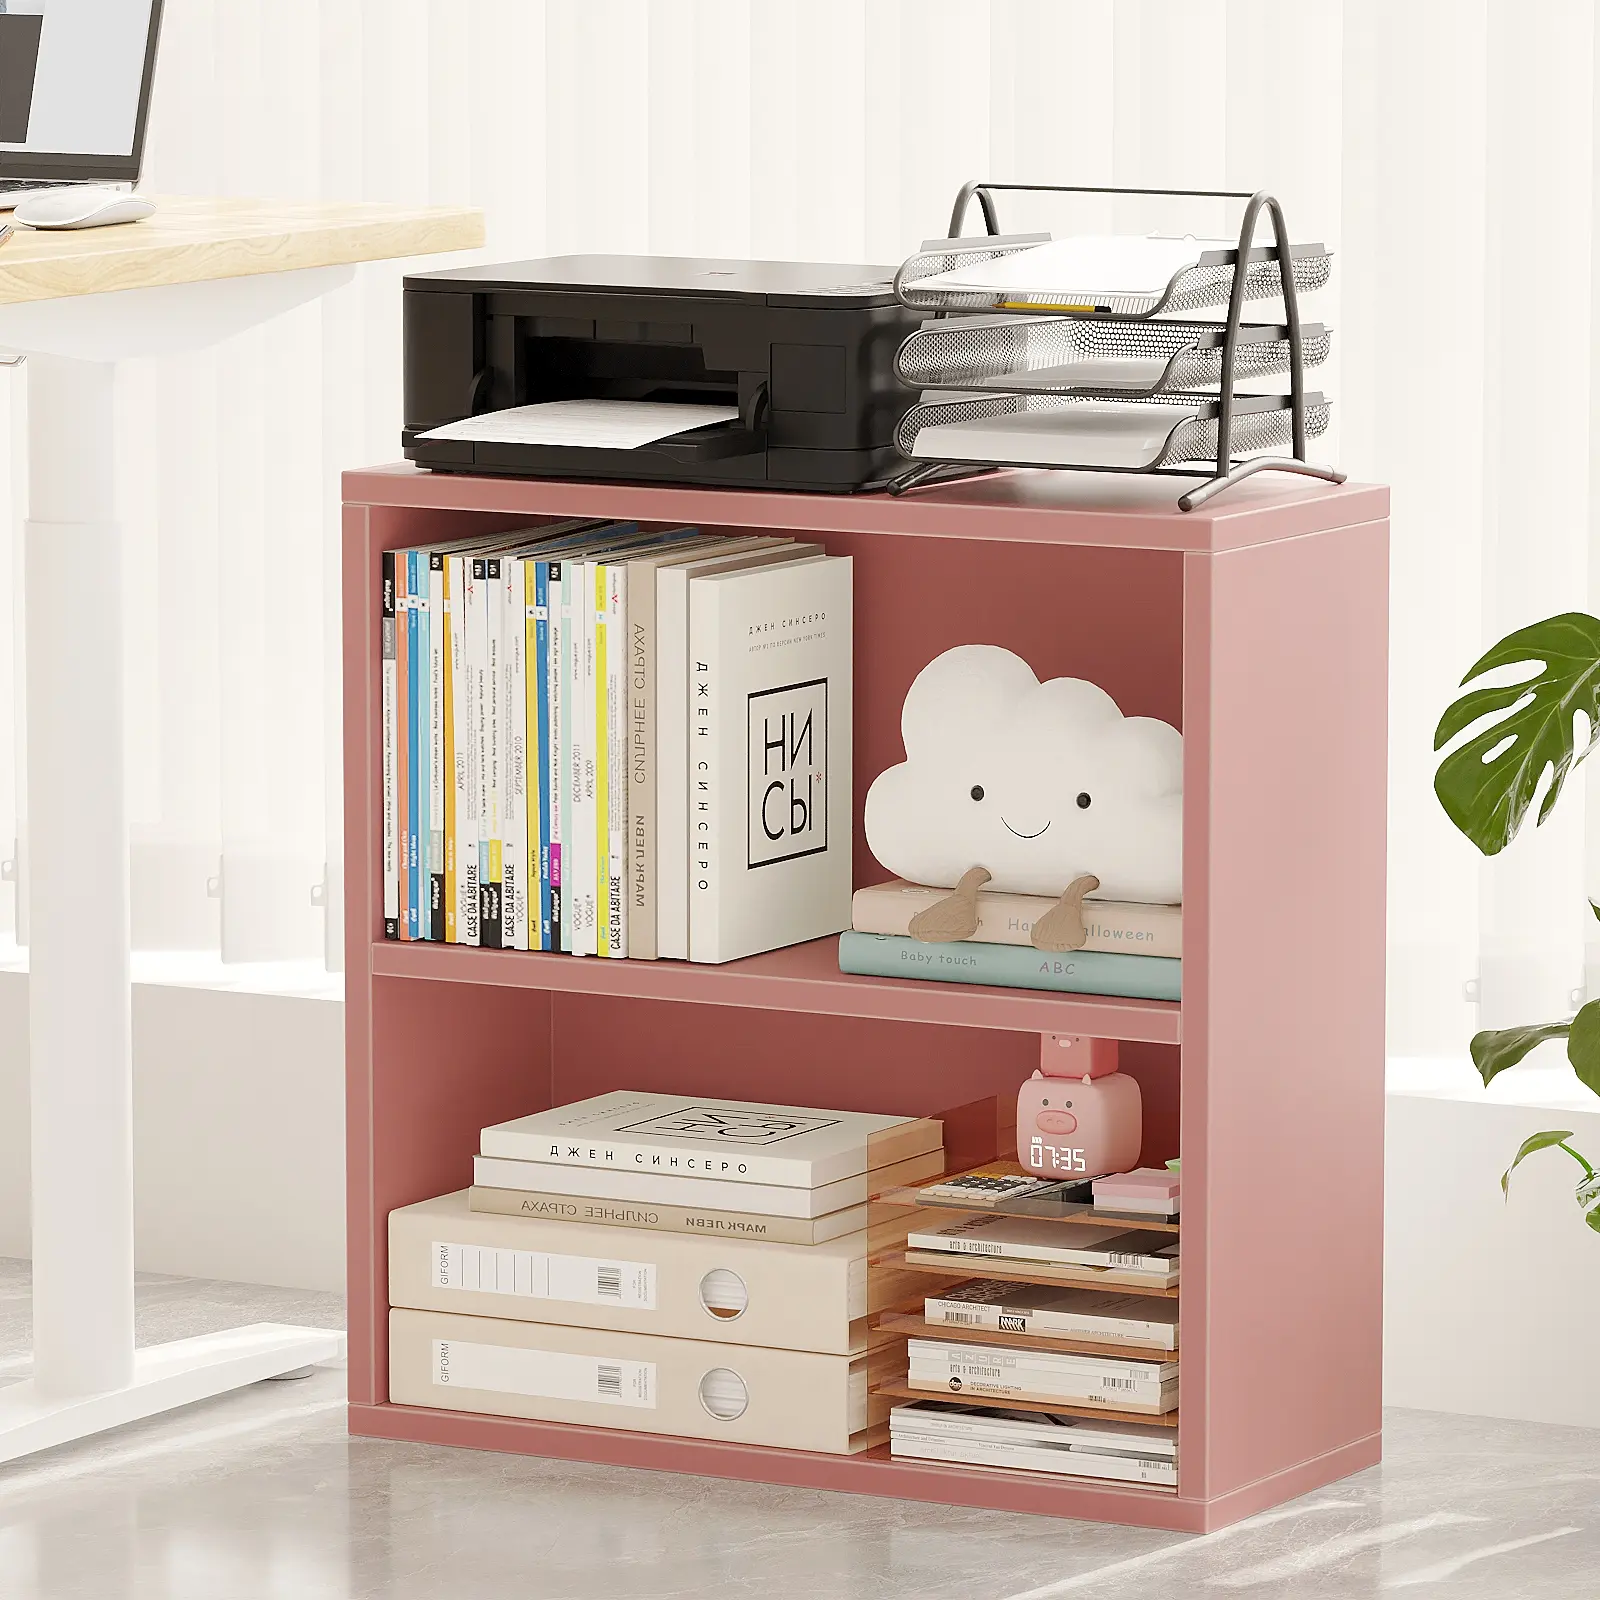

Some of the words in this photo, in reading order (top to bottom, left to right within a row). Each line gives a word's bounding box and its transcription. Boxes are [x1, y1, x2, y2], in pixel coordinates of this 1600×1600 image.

[749, 622, 774, 636] ДЖЕН
[782, 612, 826, 628] СИНСЕРО
[696, 662, 708, 736] ДЖЕН
[764, 708, 813, 775] НИ
[698, 761, 708, 890] СИНСЕРО
[467, 864, 477, 900] ABITARE
[505, 864, 515, 900] ABITARE
[611, 876, 620, 912] ABITARE
[467, 902, 477, 913] DA
[505, 902, 515, 913] DA
[467, 916, 477, 937] CASE
[505, 916, 515, 937] CASE
[611, 914, 620, 926] DA
[611, 928, 620, 949] CASE
[1083, 924, 1154, 941] alloween
[901, 951, 932, 964] Baby
[939, 954, 977, 966] touch
[1039, 961, 1075, 975] ABC
[550, 1145, 614, 1161] ДЖЕН
[635, 1153, 747, 1174] СИНСЕРО
[1030, 1144, 1086, 1172] 07:35
[969, 1242, 1002, 1254] architecture
[440, 1245, 449, 1285] GIFORM
[962, 1304, 991, 1312] ARCHITECT
[1000, 1317, 1024, 1332] MARK
[440, 1342, 449, 1383] GIFORM
[951, 1352, 1015, 1365] AZURE
[950, 1364, 960, 1373] arts
[969, 1365, 1000, 1377] architecture
